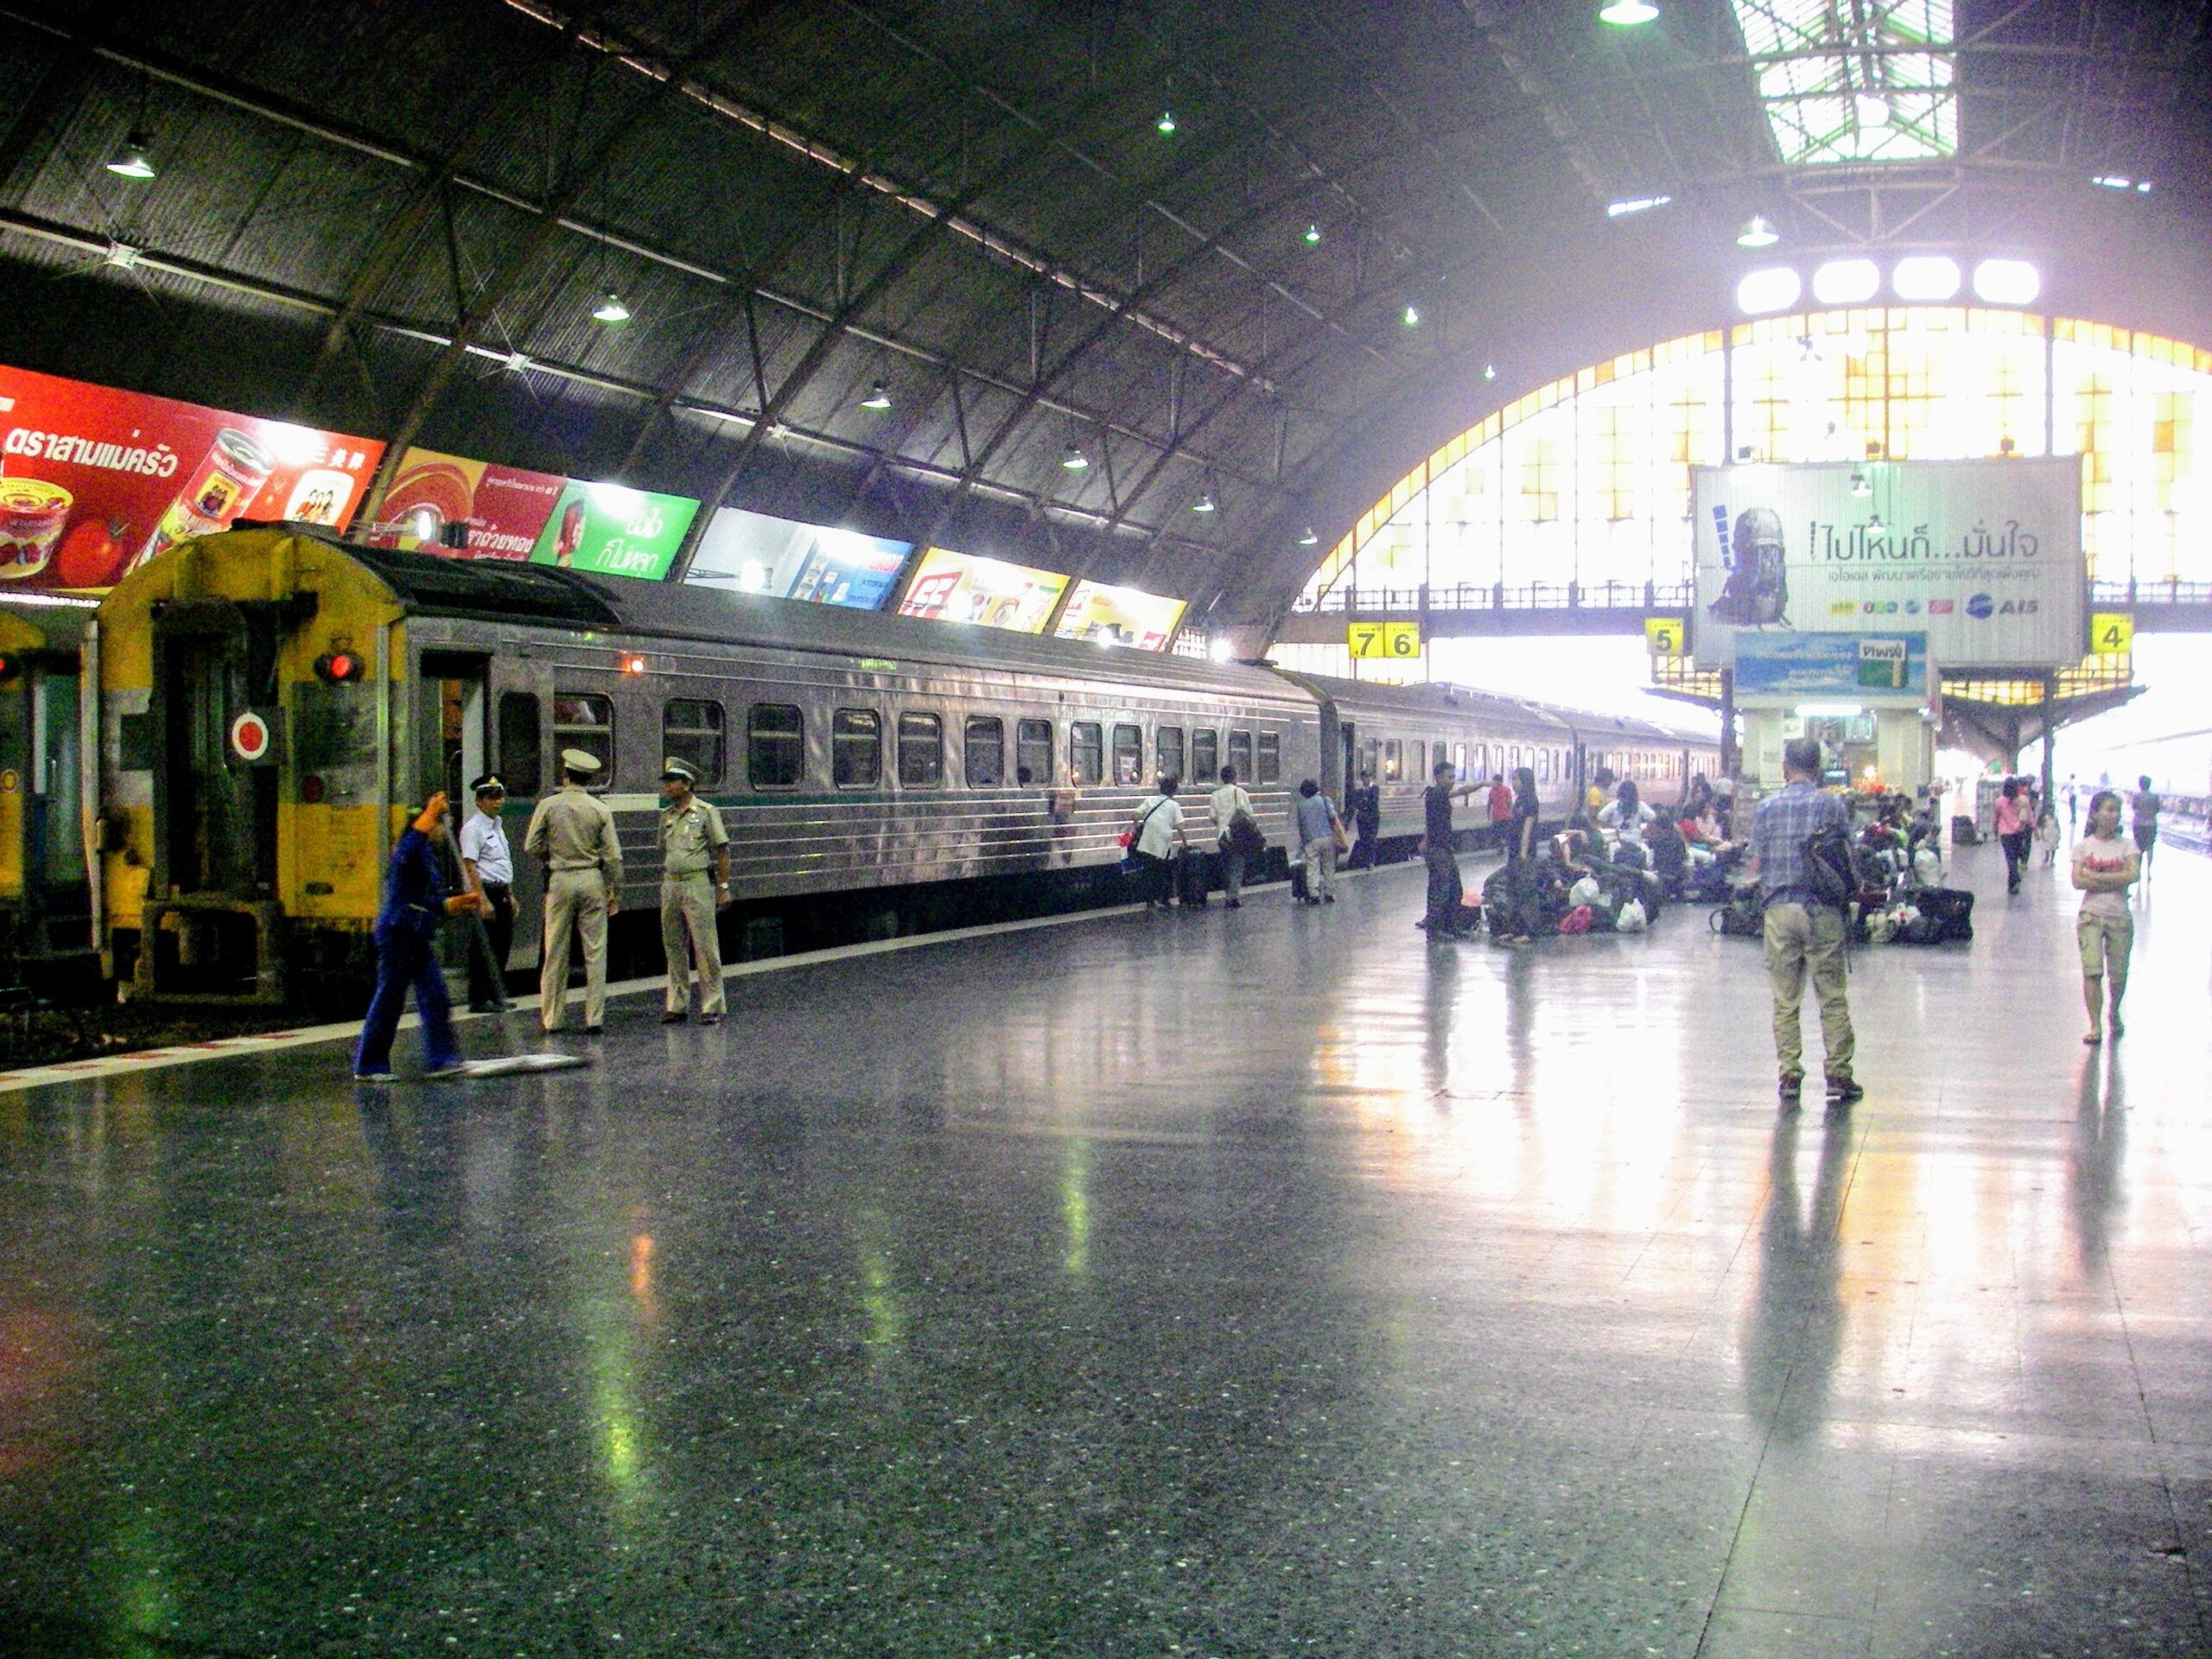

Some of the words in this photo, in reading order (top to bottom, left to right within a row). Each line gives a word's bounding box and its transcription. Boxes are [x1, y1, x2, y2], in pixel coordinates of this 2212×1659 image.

[6, 428, 179, 478] ตราสามแม่ครัว
[1999, 599, 2039, 614] AIS
[1357, 632, 1376, 656] 7
[1394, 633, 1411, 656] 6
[1656, 629, 1672, 652] 5
[2102, 625, 2124, 648] 4
